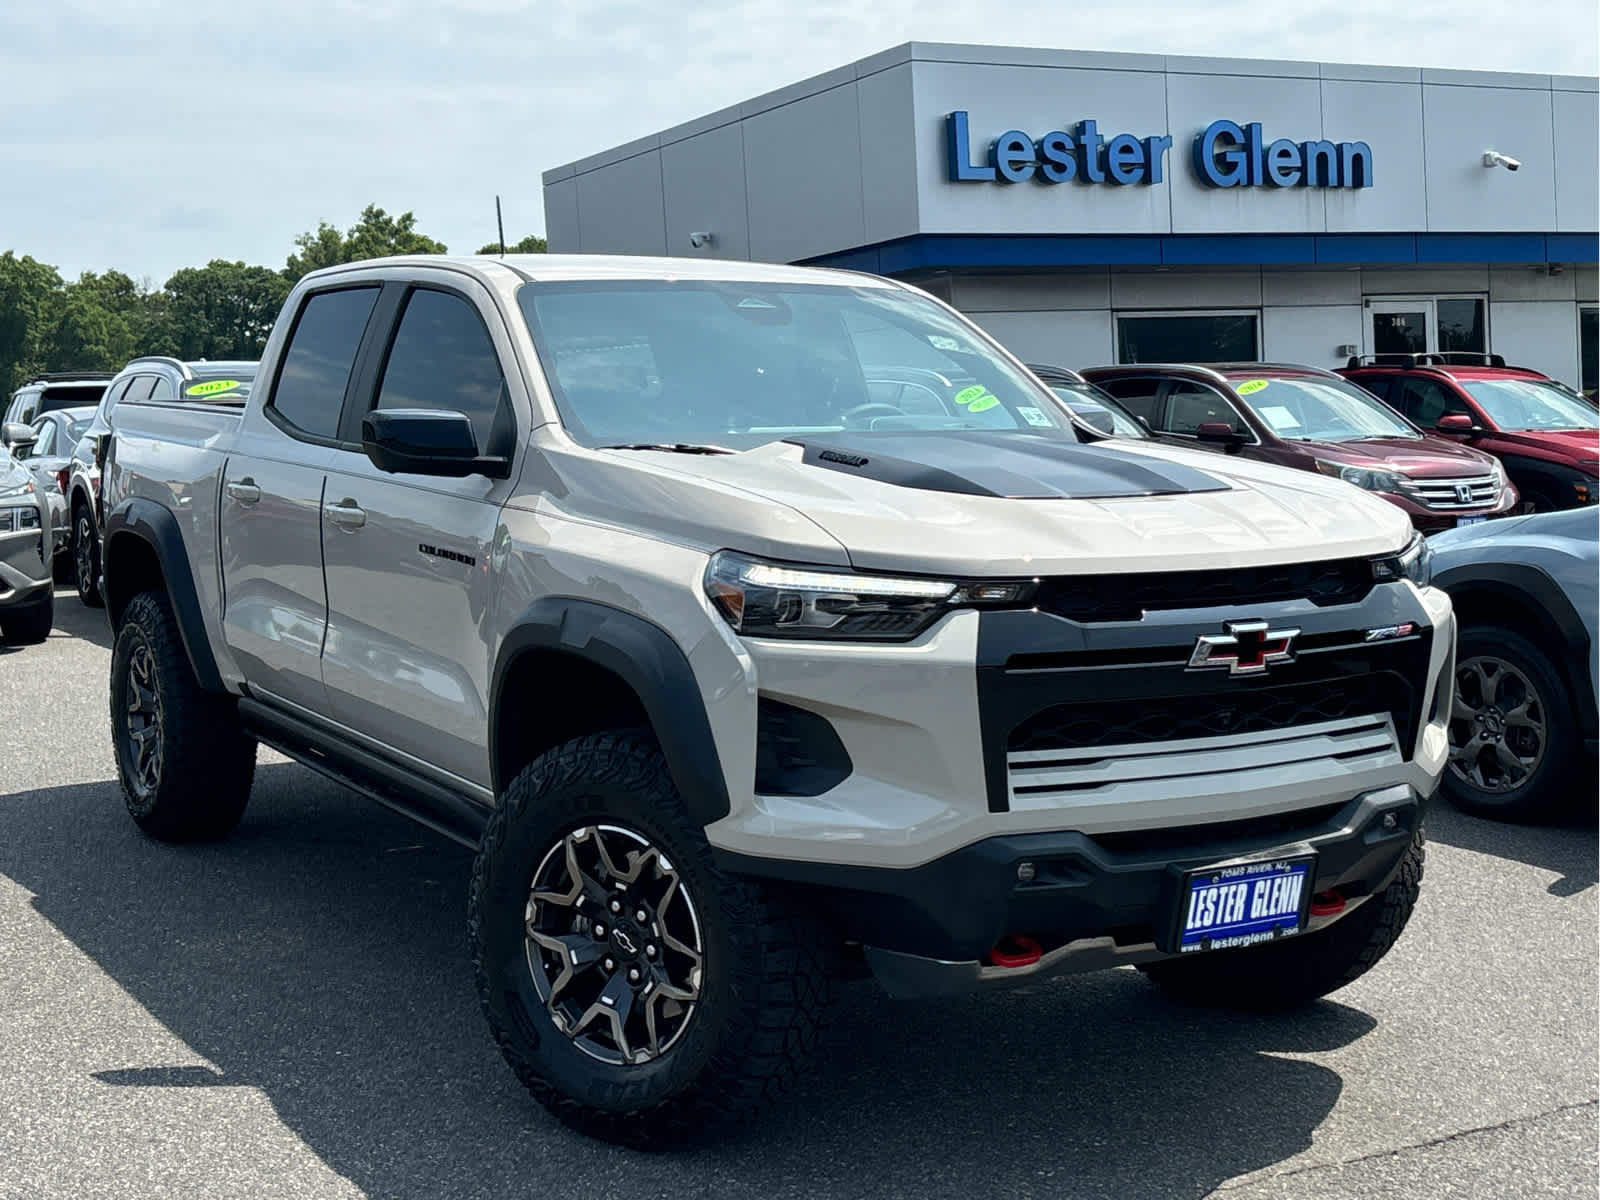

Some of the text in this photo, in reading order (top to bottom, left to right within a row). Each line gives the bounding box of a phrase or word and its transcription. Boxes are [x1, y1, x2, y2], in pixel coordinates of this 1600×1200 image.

[946, 111, 1373, 188] Lester Glenn
[1221, 867, 1245, 878] TOMS
[1186, 874, 1304, 930] LESTER GLENN
